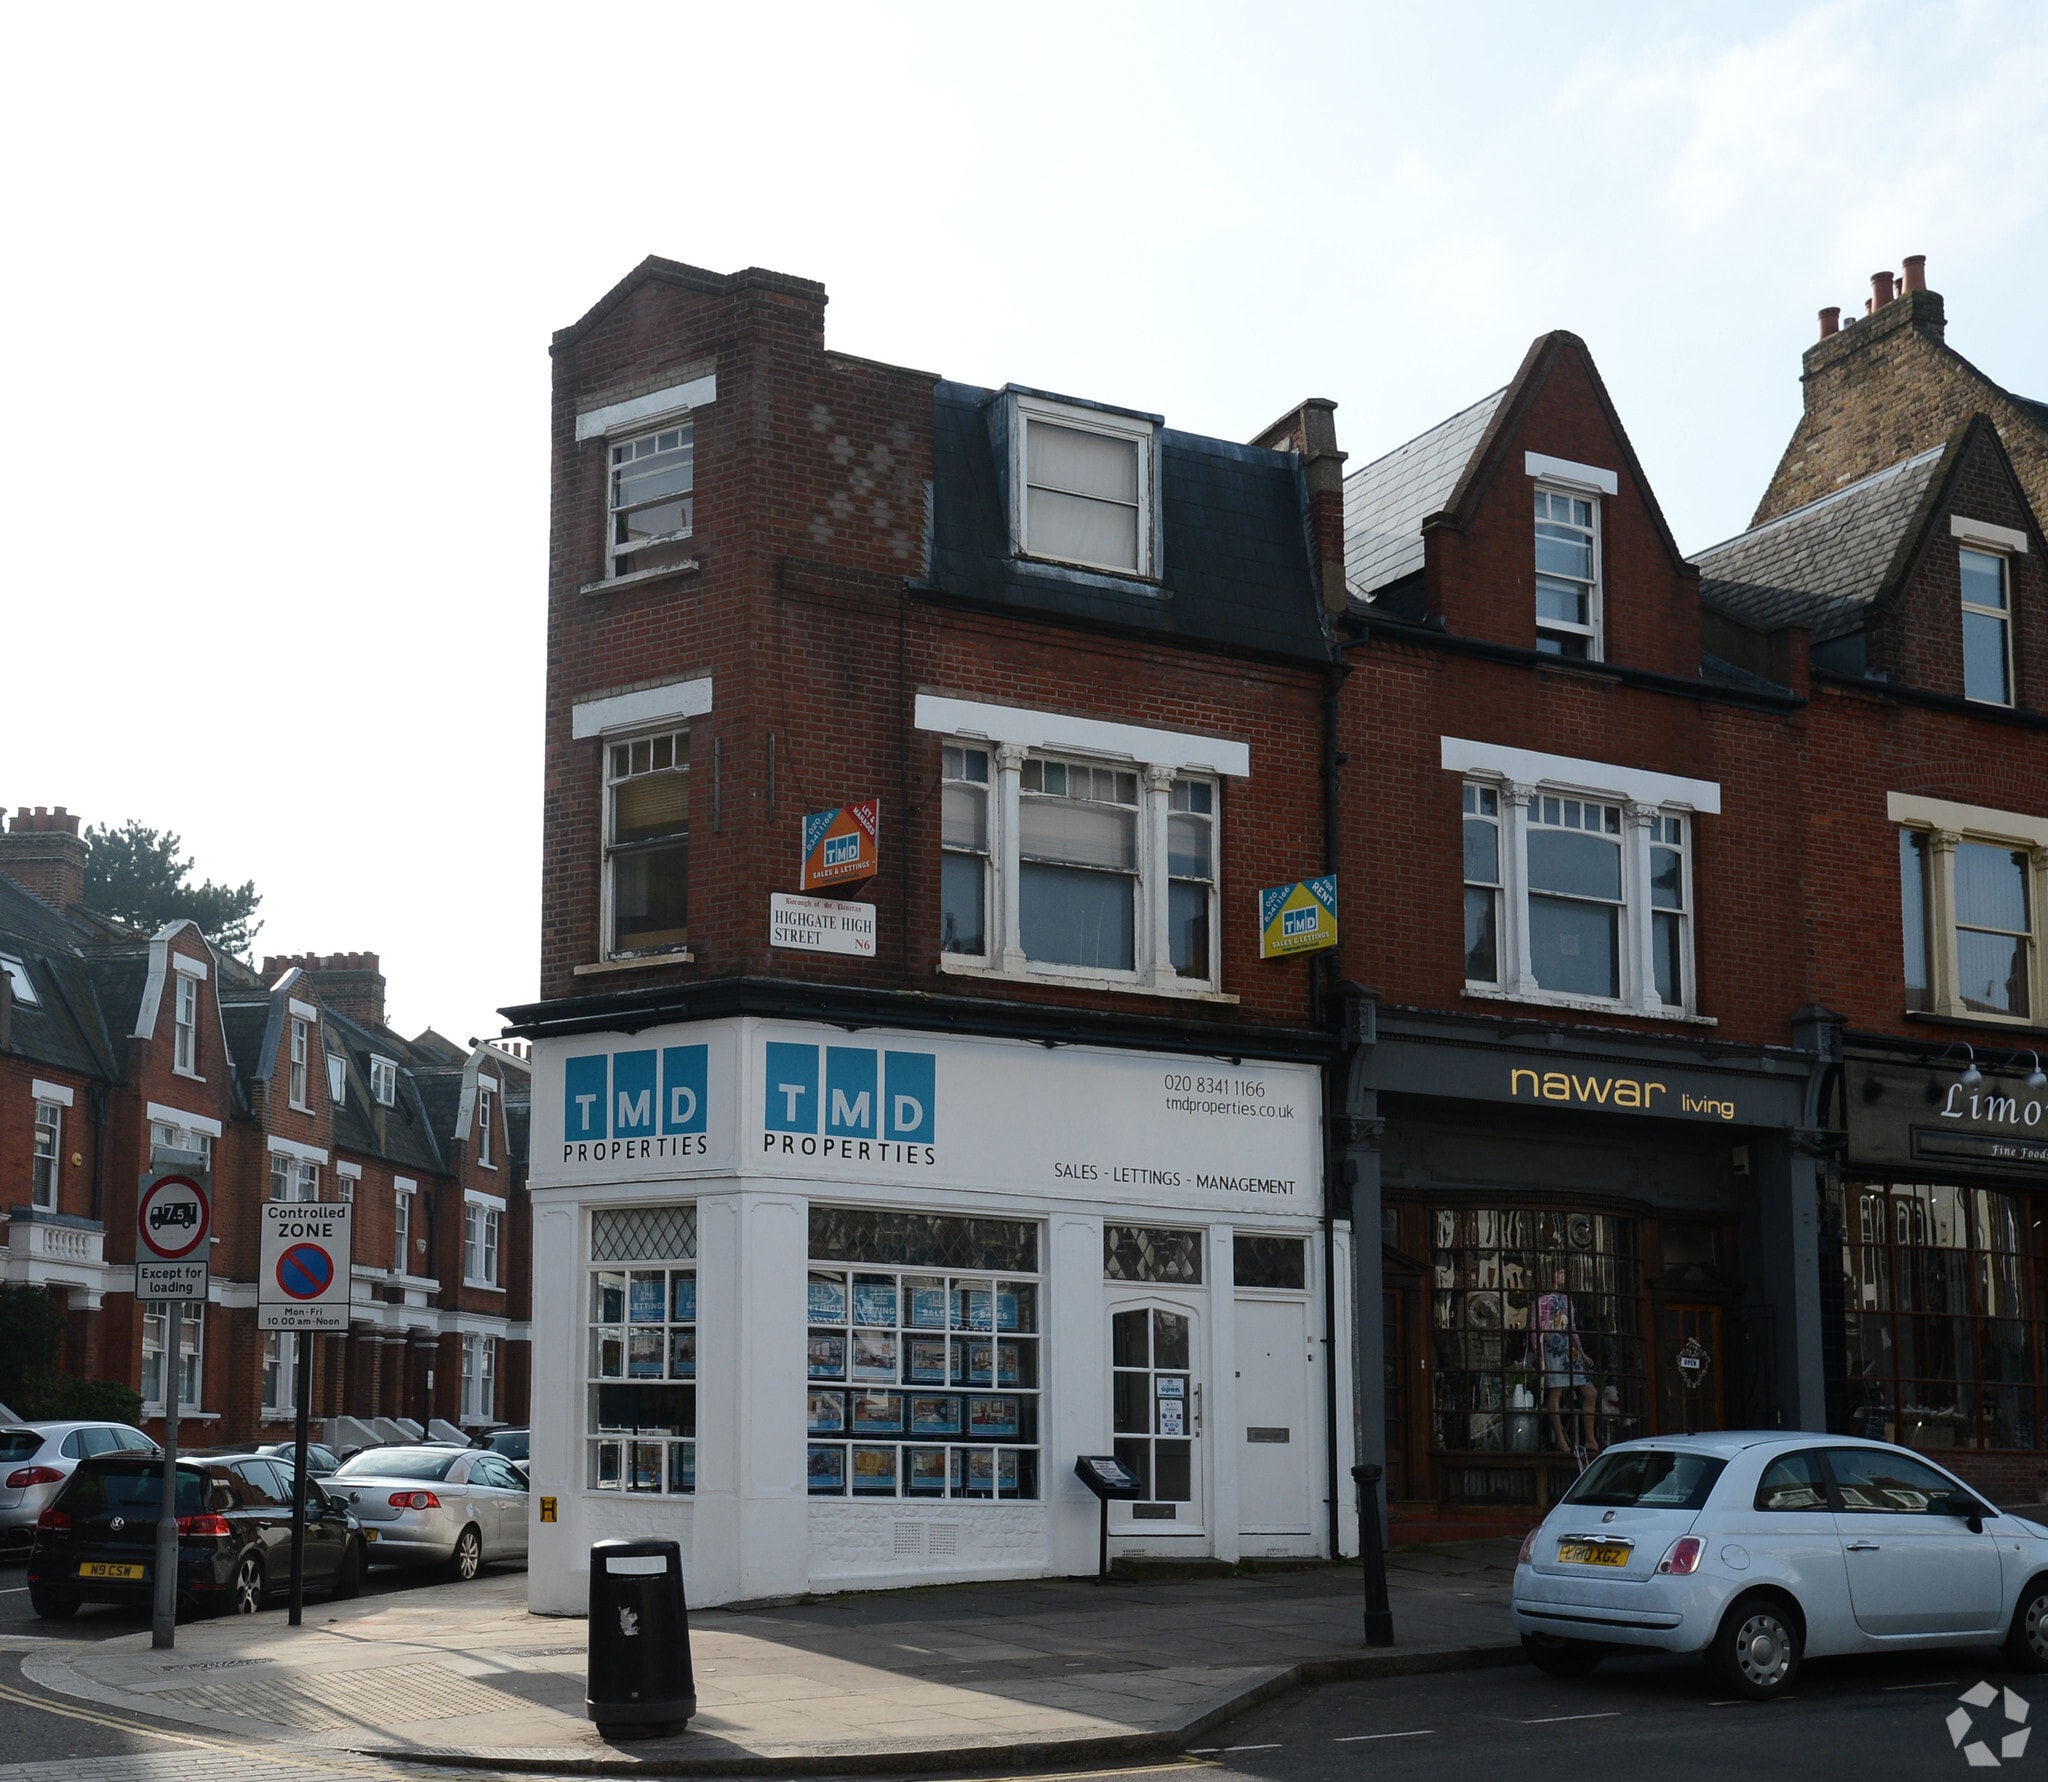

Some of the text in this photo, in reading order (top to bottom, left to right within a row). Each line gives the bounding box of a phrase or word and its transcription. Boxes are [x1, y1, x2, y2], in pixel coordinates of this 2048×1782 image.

[861, 805, 872, 818] LET
[808, 818, 821, 835] 020
[852, 806, 875, 836] MANAGED
[806, 812, 833, 851] 8341 1166
[827, 845, 857, 863] TMD
[812, 869, 833, 879] SALES
[840, 860, 870, 873] LETTINGS
[1311, 882, 1334, 906] RENT
[1322, 879, 1334, 892] FOR
[785, 897, 812, 908] Borough
[837, 903, 861, 912] Pancras
[1264, 887, 1290, 922] 8341 1166
[1265, 891, 1278, 907] 020
[775, 910, 872, 934] HIGHGATE HIGH
[1285, 917, 1316, 933] TMD
[774, 927, 822, 945] STREET
[855, 939, 870, 950] N6
[1272, 938, 1292, 948] SALES
[1299, 931, 1330, 942] LETTINGS
[1164, 1074, 1266, 1098] 020 8341 1166
[1511, 1068, 1735, 1120] nawar living
[575, 1086, 698, 1131] TMD
[778, 1083, 924, 1132] TMD
[1165, 1096, 1295, 1119] tmdproperties.co.uk
[1940, 1083, 2048, 1126] Limo
[563, 1135, 708, 1163] PROPERTIES
[764, 1133, 935, 1165] PROPERTIES
[1991, 1144, 2016, 1157] Fine
[1054, 1162, 1098, 1180] SALES
[1113, 1166, 1181, 1187] LETTINGS
[1196, 1174, 1296, 1195] MANAGEMENT
[165, 1204, 196, 1220] 7.5 T
[268, 1207, 346, 1219] Controlled
[278, 1223, 333, 1238] ZONE
[141, 1267, 203, 1280] Except for
[150, 1282, 193, 1295] loading
[267, 1317, 295, 1326] 10.00
[1684, 1359, 1697, 1367] OPEN
[542, 1498, 555, 1521] H
[1594, 1548, 1621, 1564] XGZ
[90, 1564, 132, 1577] N9 CSW
